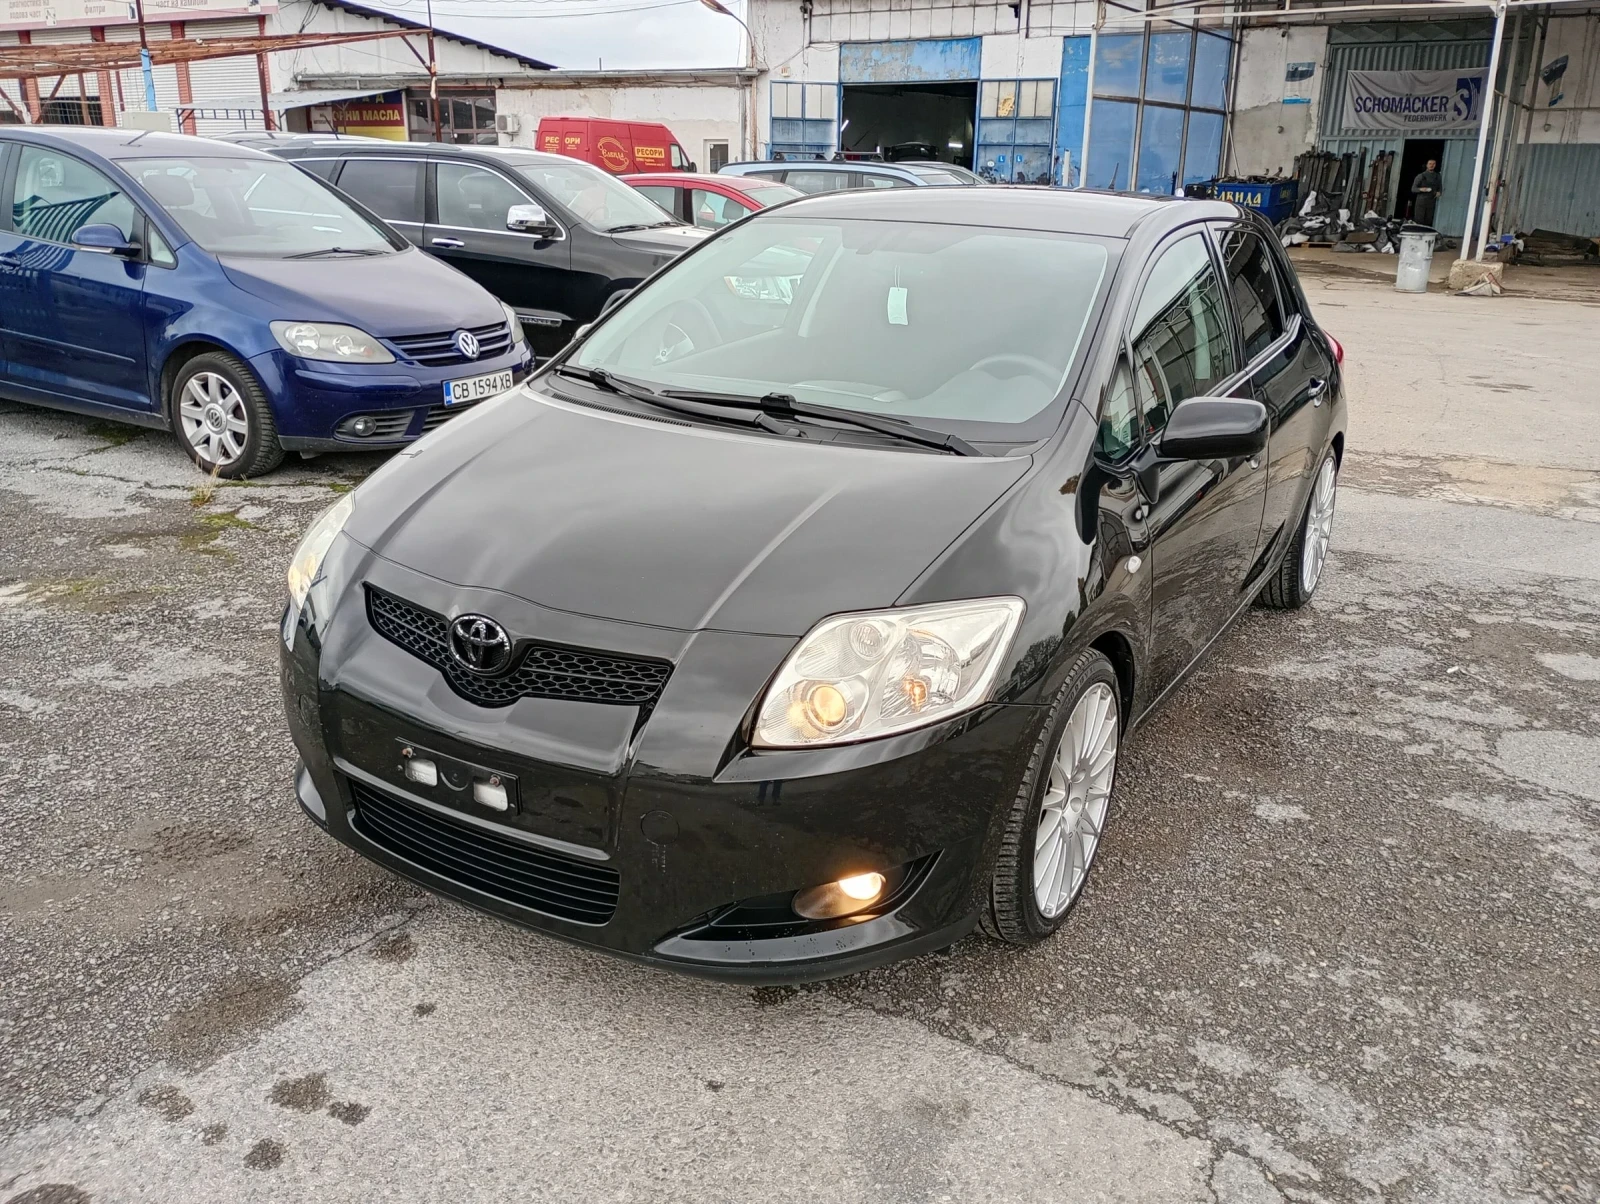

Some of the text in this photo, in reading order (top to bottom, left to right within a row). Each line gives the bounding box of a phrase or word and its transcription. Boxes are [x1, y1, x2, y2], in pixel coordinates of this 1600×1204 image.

[1354, 93, 1449, 112] SCHOMÄCKER
[363, 109, 401, 121] МАСЛА
[1403, 114, 1447, 122] FEDERNWERK
[545, 136, 581, 145] РЕС ОРИ
[636, 148, 663, 157] РЕСОРИ
[452, 373, 512, 400] CB 1594 XB
